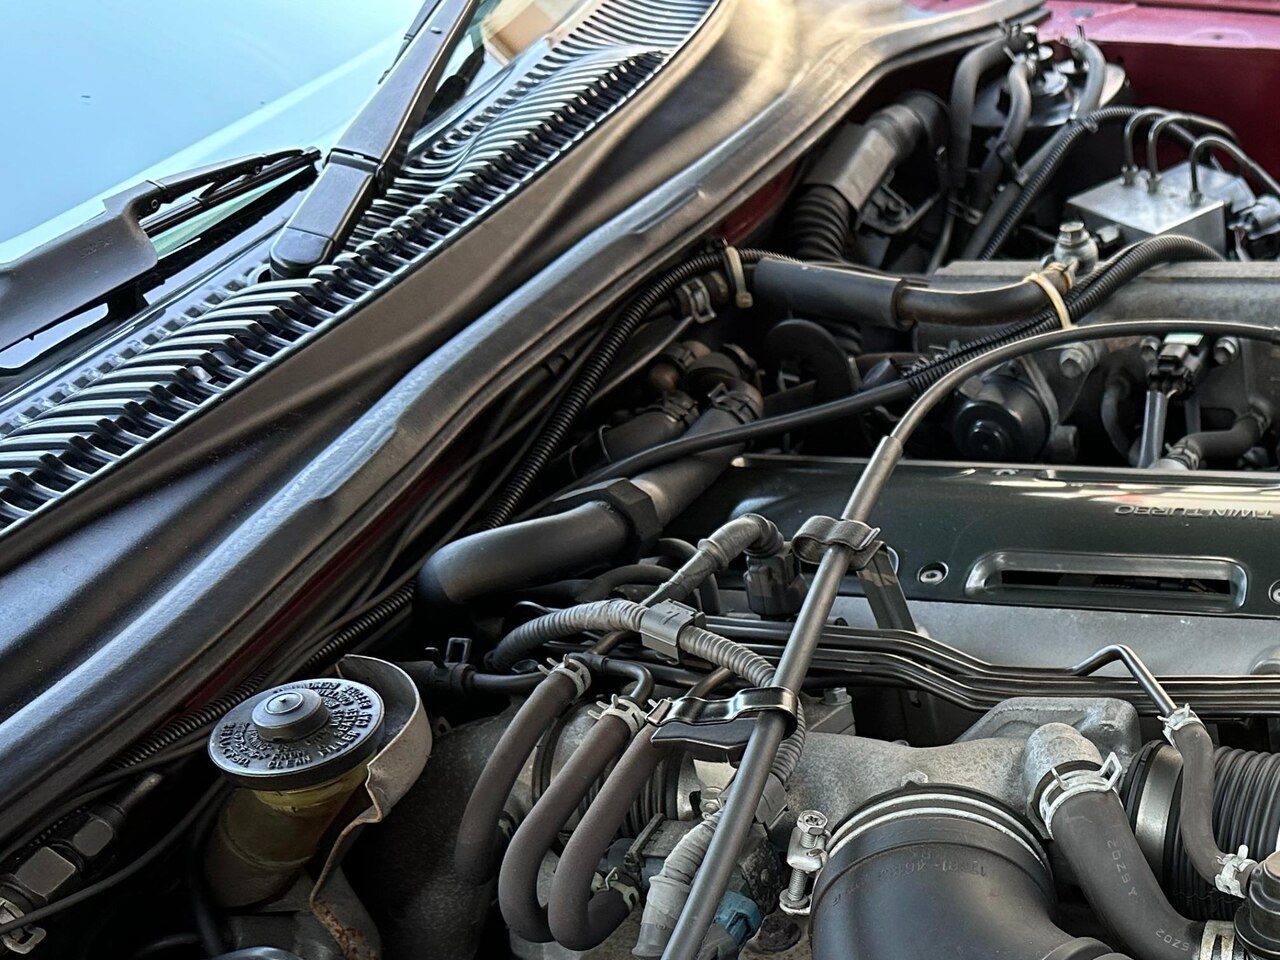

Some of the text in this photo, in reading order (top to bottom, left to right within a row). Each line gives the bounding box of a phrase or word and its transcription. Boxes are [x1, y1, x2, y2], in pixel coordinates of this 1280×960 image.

[1113, 505, 1206, 518] TURBO
[1206, 506, 1274, 519] TWIN
[267, 754, 312, 770] CLEAN
[317, 731, 362, 758] FILLER
